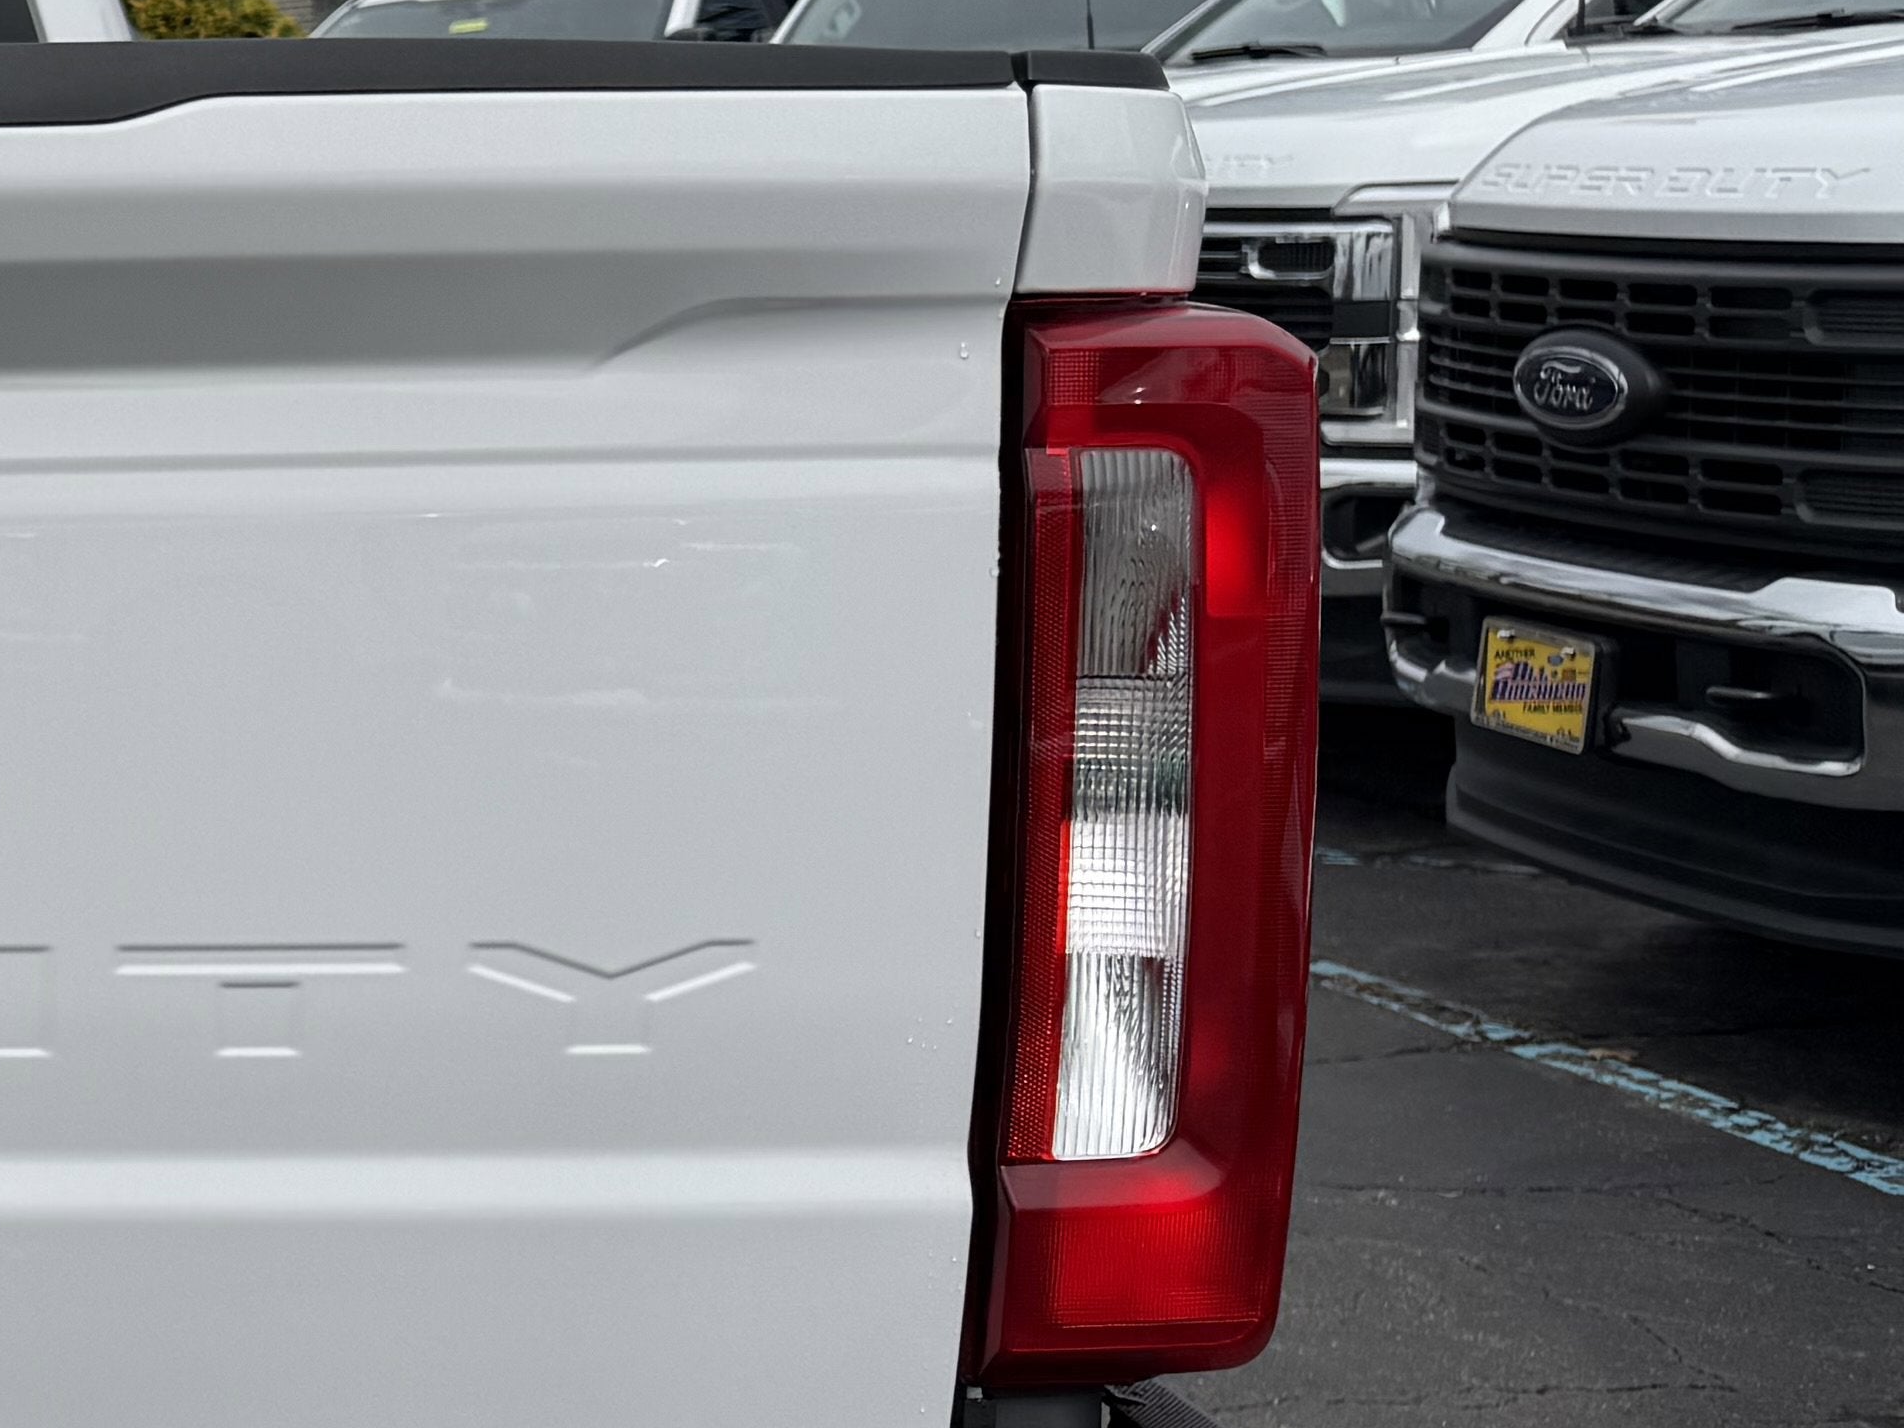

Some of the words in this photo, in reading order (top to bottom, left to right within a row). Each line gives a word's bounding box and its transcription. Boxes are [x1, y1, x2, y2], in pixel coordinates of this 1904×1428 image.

[1481, 163, 1654, 197] SUPER
[1656, 166, 1871, 200] DUTY
[1533, 359, 1597, 412] Ford
